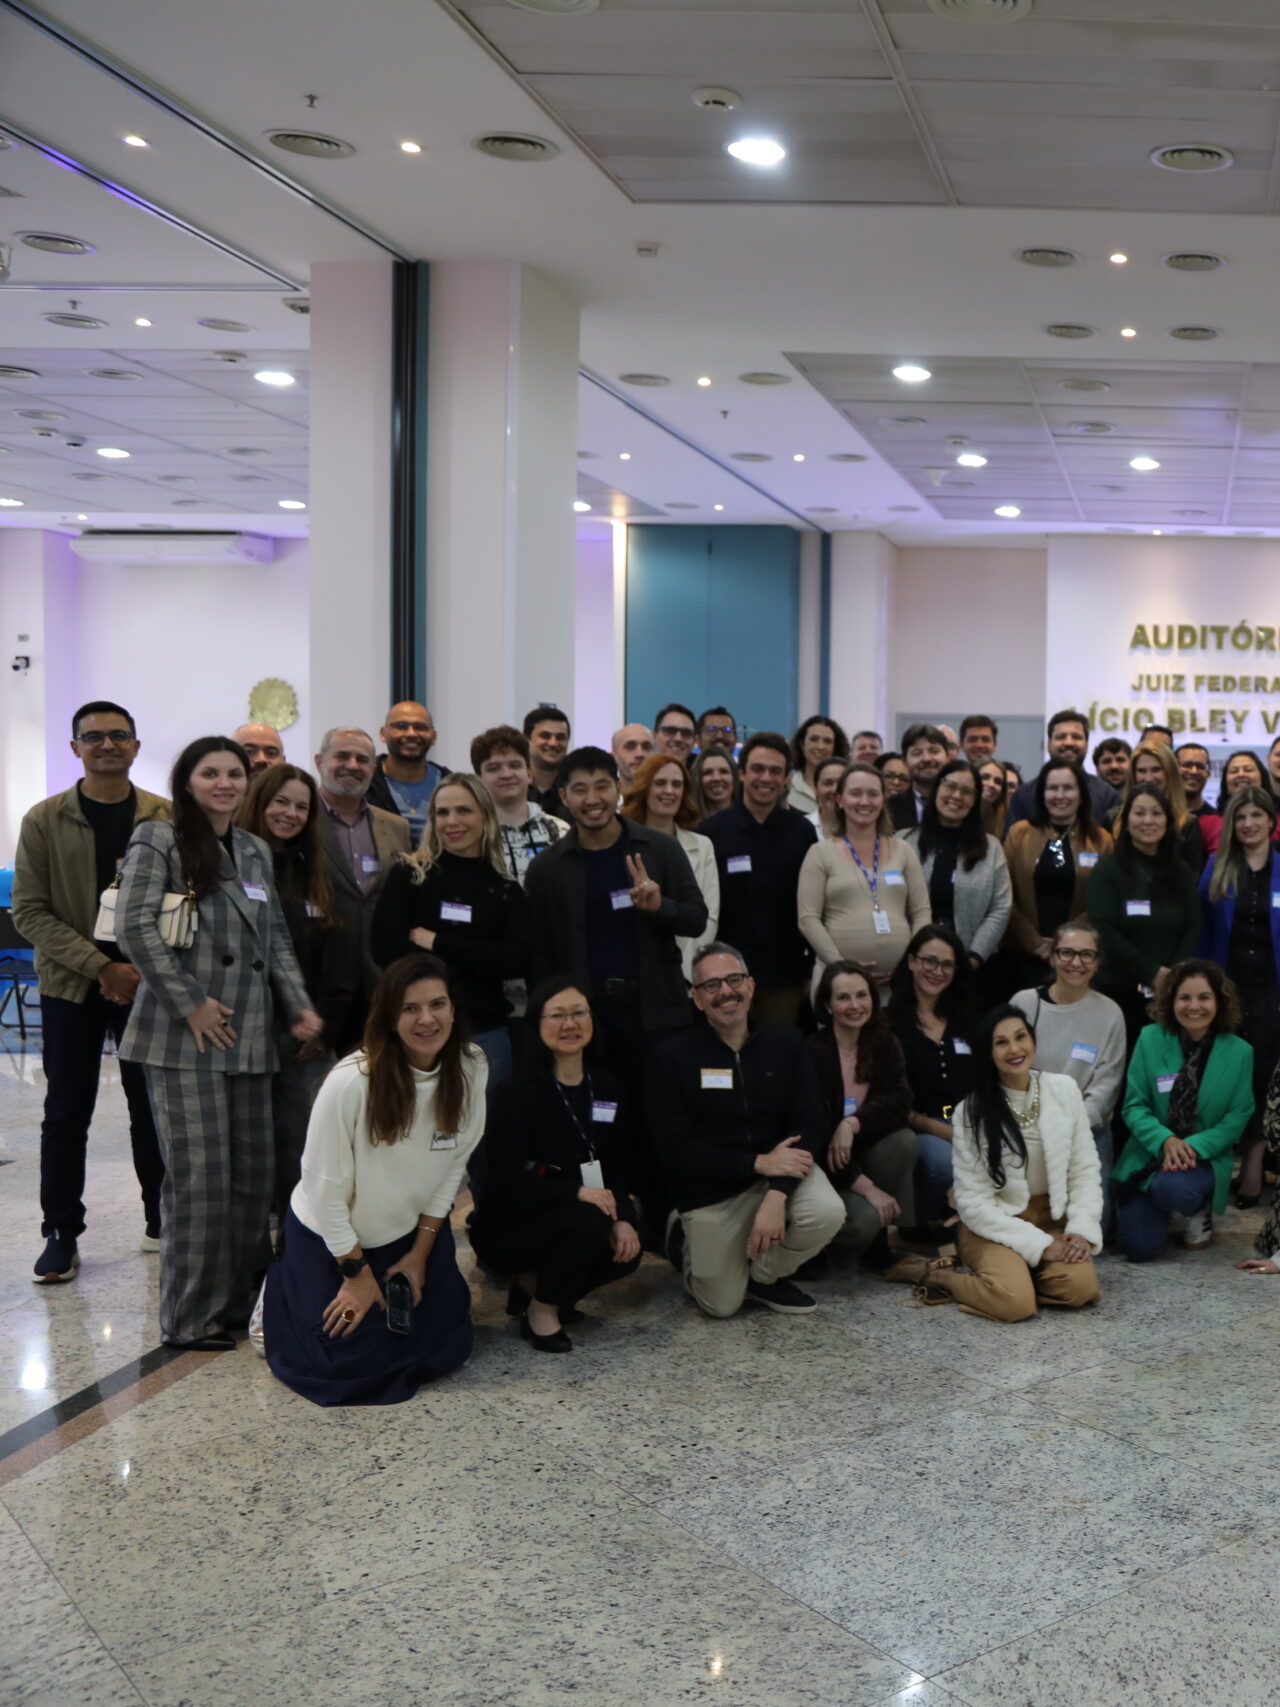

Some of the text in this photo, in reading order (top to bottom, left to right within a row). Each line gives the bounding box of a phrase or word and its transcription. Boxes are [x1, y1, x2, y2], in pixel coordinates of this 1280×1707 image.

[1132, 674, 1185, 692] JUIZ
[1070, 702, 1157, 732] ÍCIO
[1167, 709, 1249, 733] BLEY
